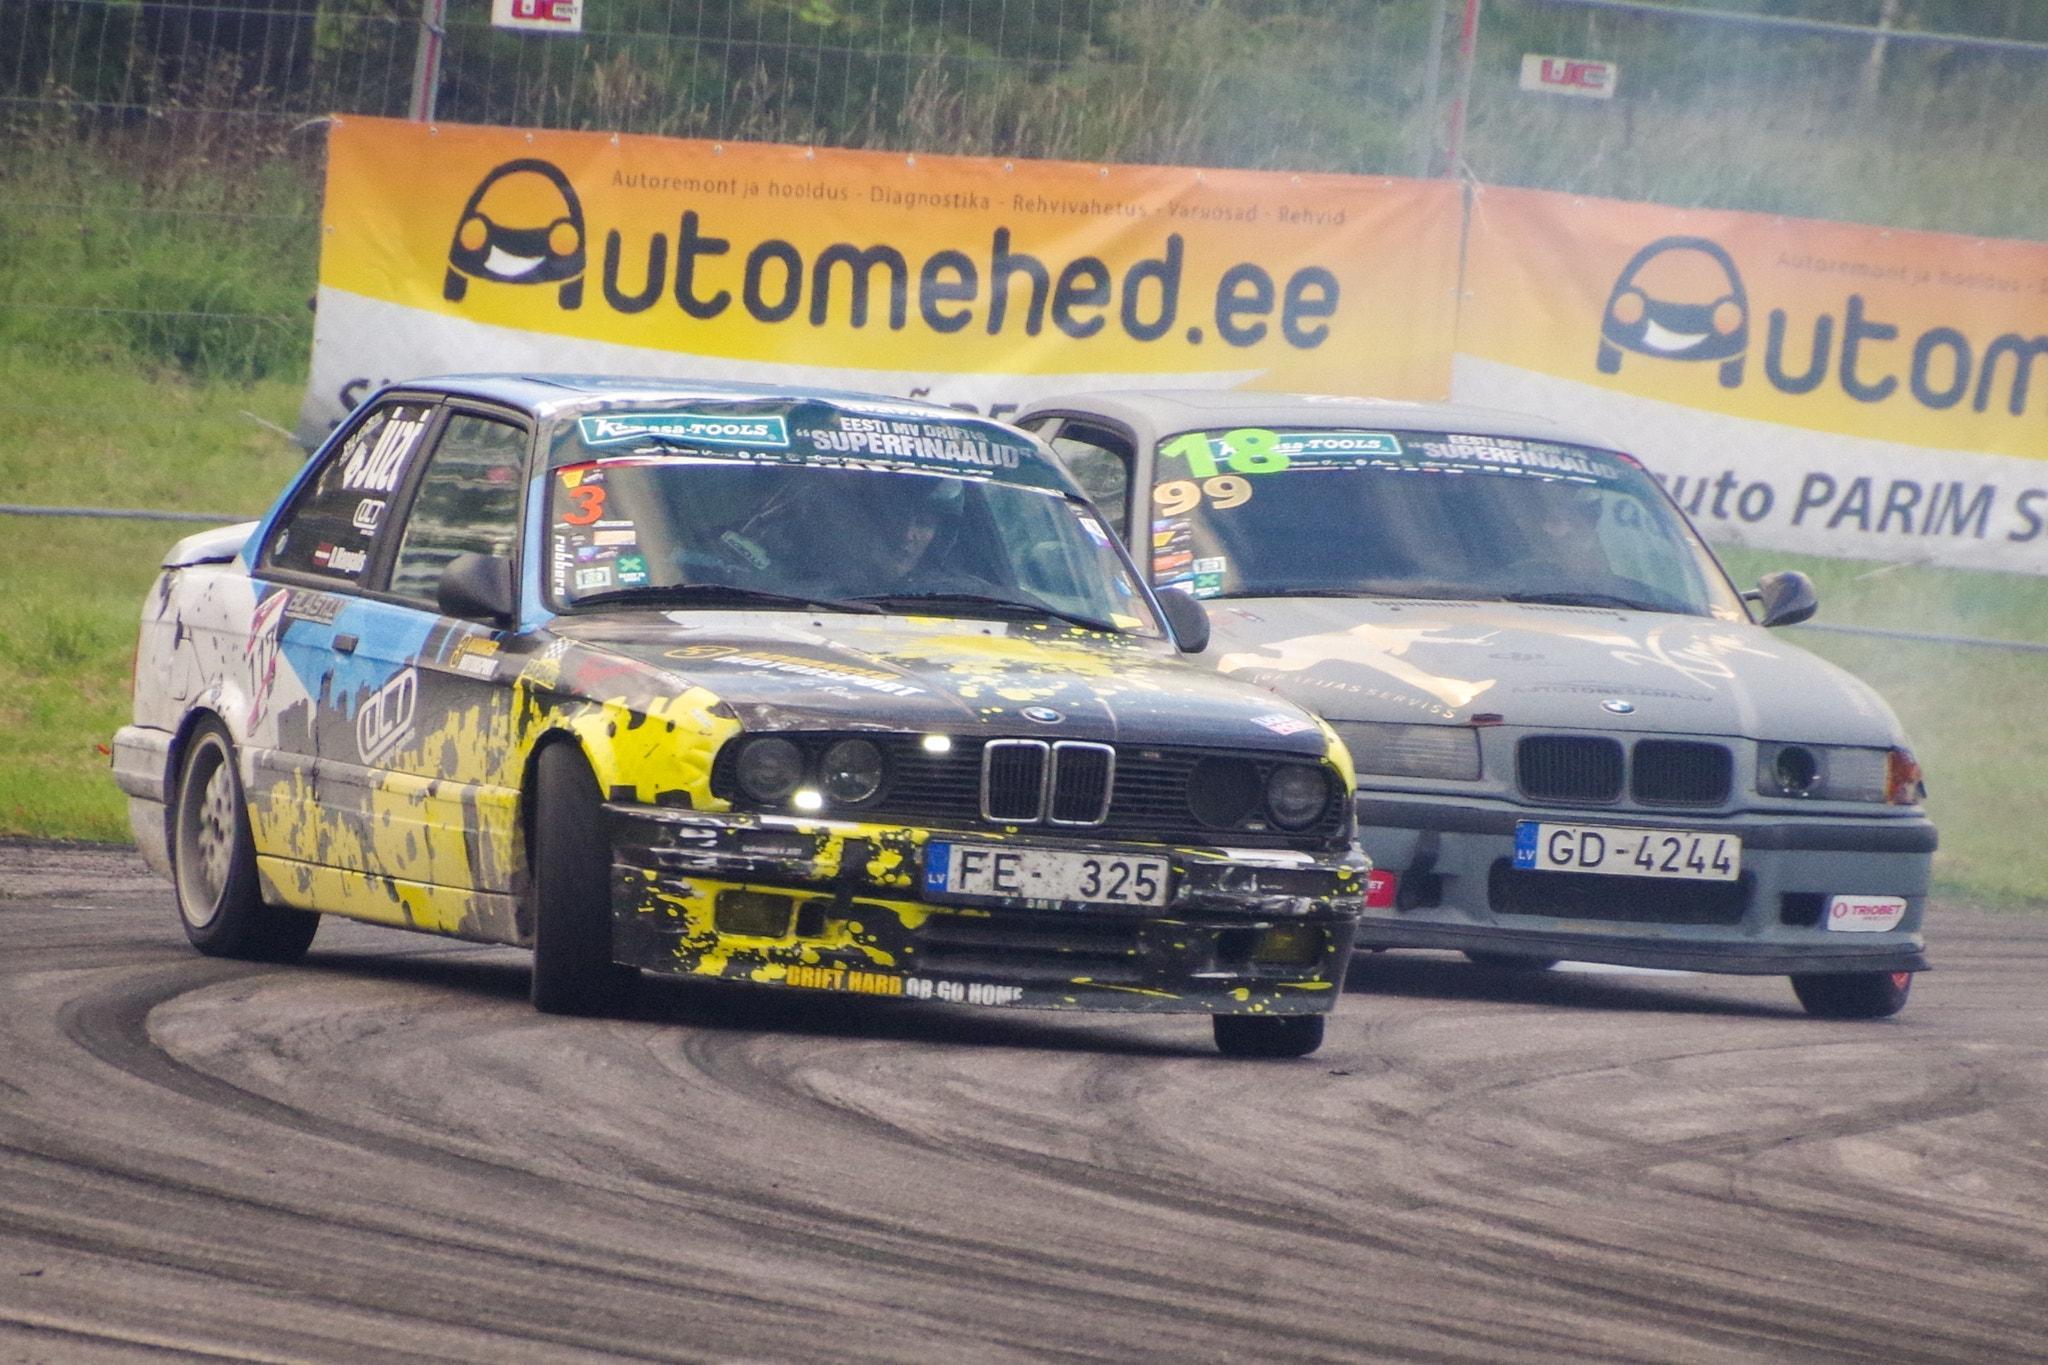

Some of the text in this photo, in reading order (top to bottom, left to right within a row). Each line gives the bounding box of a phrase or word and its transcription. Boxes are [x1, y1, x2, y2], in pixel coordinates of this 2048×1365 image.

[612, 170, 737, 195] Autoremont
[742, 179, 759, 199] ja
[768, 179, 849, 200] hooldus
[870, 186, 990, 210] Diagnostika
[1013, 194, 1146, 217] Rehvivahetus
[1278, 206, 1346, 226] Rehvid
[840, 417, 889, 433] EESTI
[892, 423, 920, 438] MV
[1160, 428, 1291, 478] 18
[562, 485, 606, 525] 3
[1153, 475, 1252, 517] 99
[1655, 470, 1774, 522] uto
[1791, 472, 1996, 539] PARIM
[1518, 850, 1534, 860] LV
[1549, 830, 1731, 875] GD-4244
[928, 873, 945, 884] LV
[786, 965, 1023, 1006] DRIFT HARD OR GO HOME
